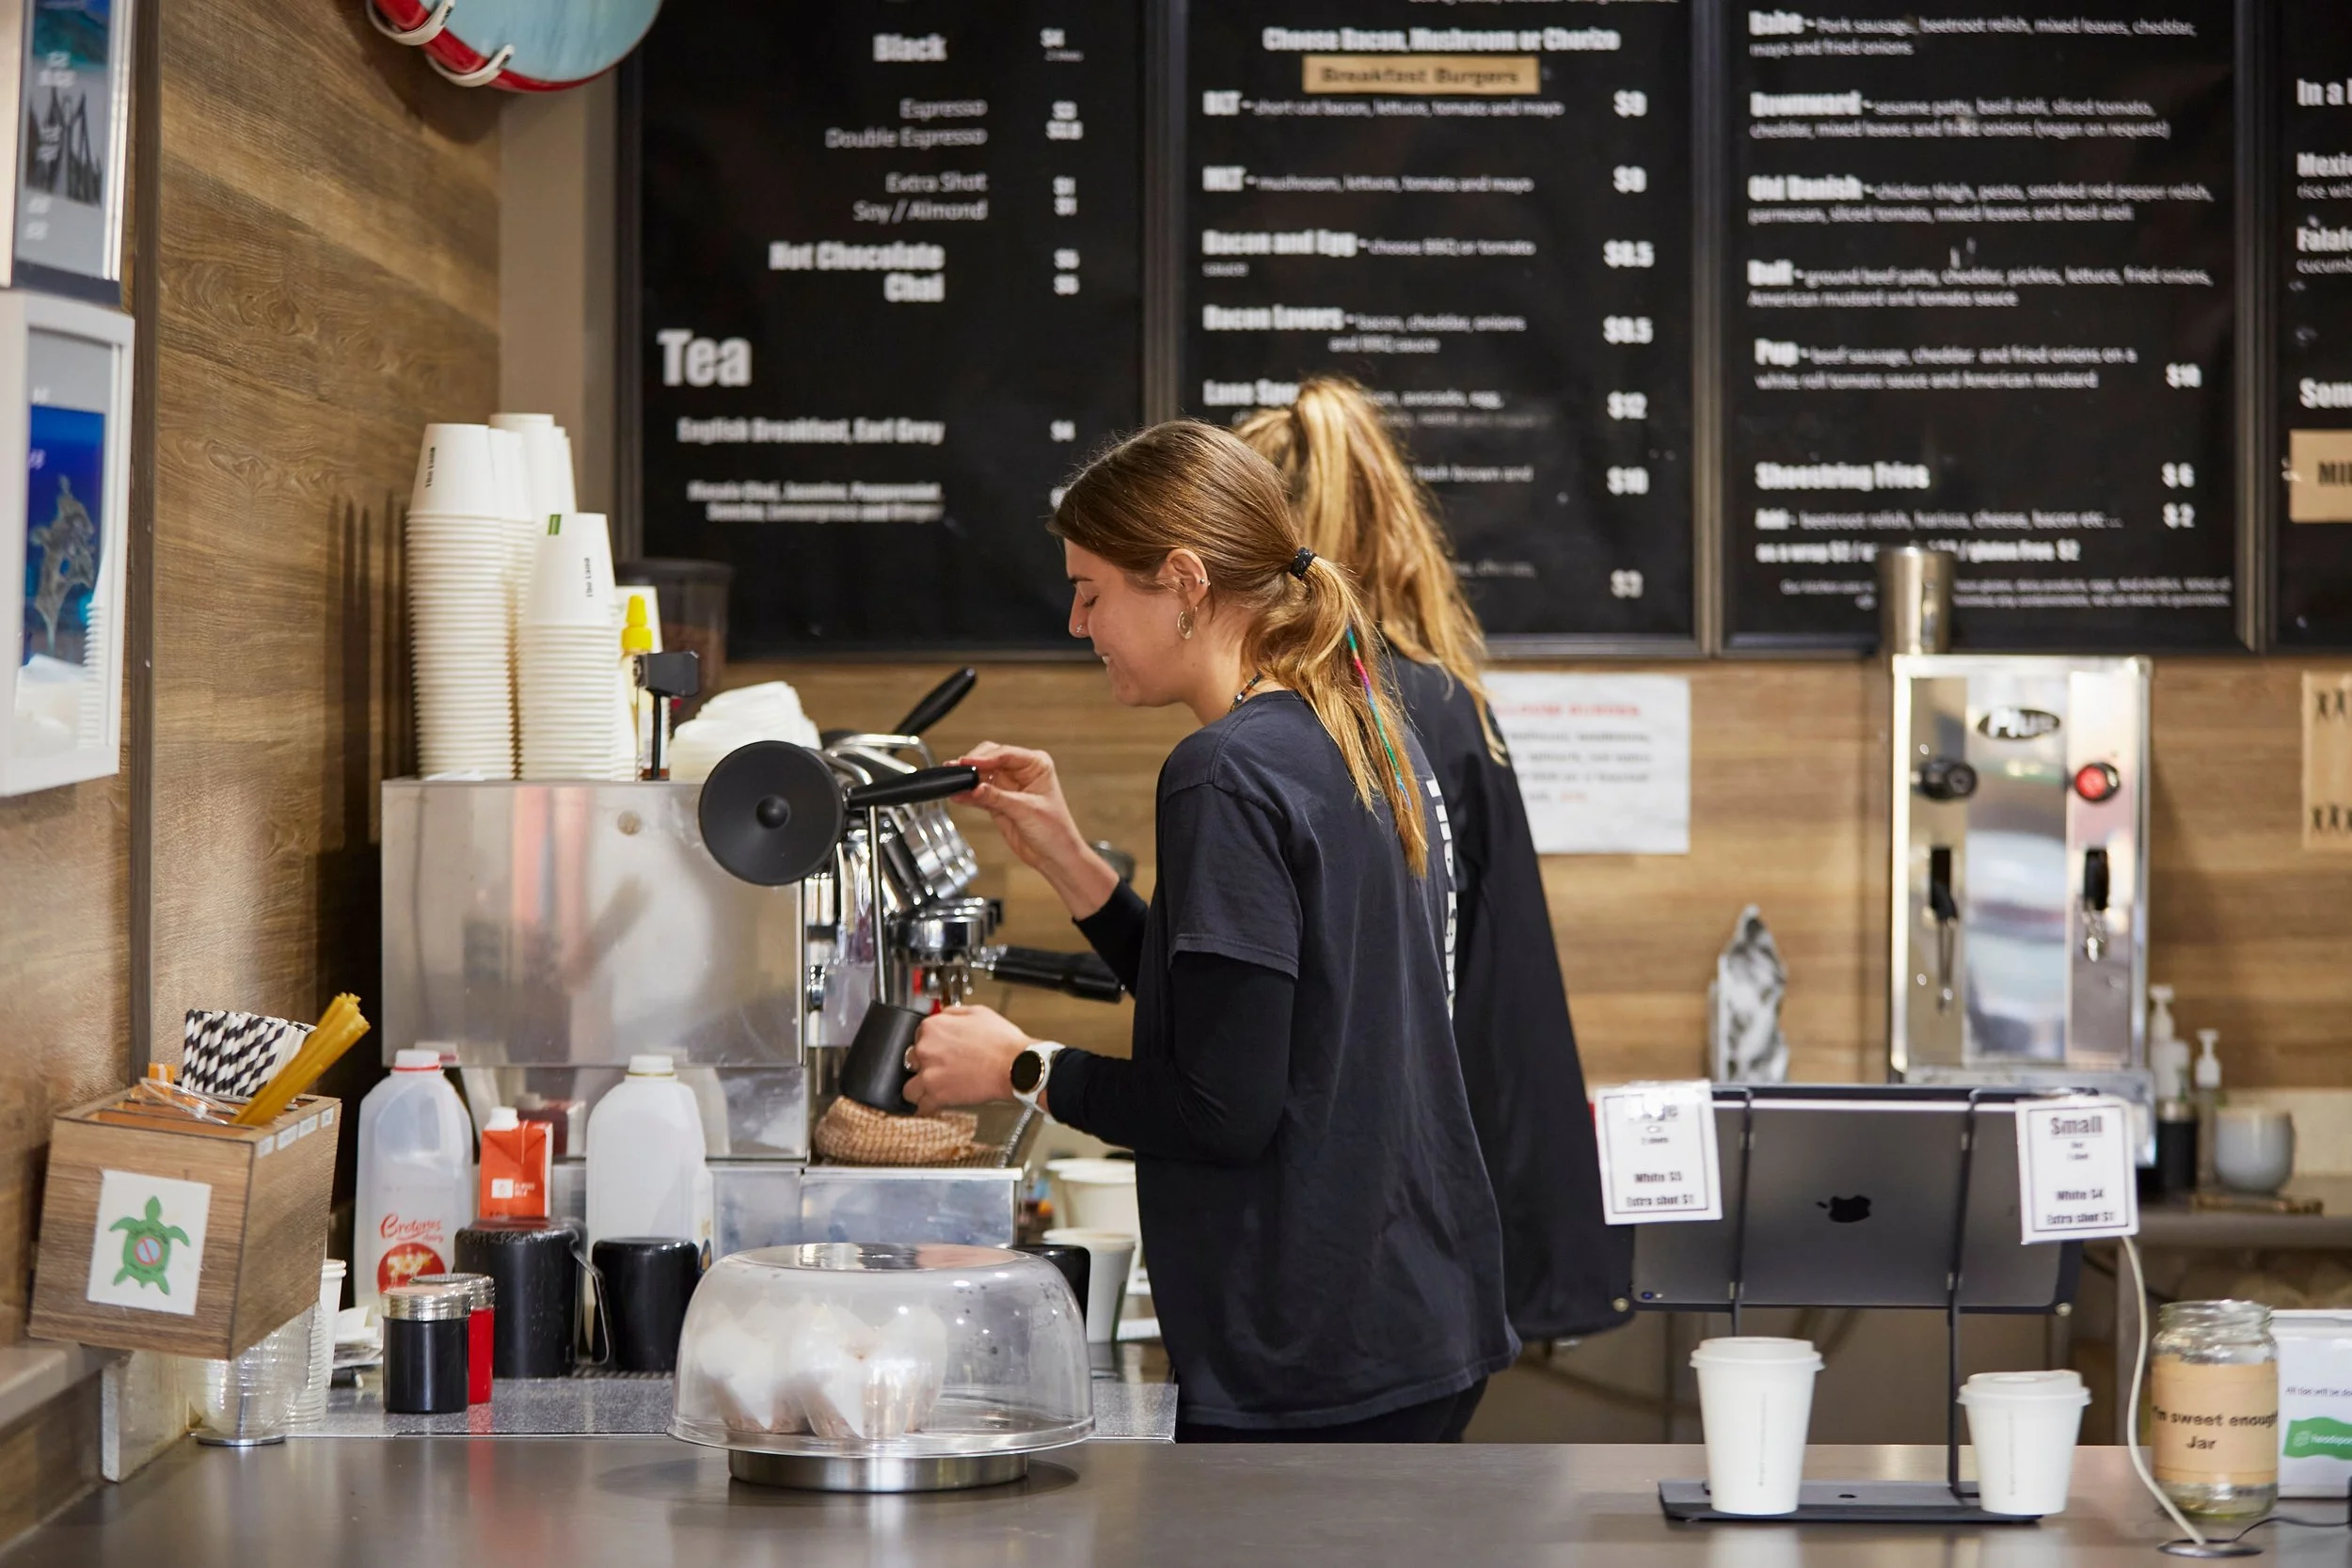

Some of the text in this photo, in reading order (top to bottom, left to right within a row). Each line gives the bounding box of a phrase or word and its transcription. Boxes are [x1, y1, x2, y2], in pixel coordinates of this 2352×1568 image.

[874, 34, 946, 61] Black
[1321, 66, 1518, 87] Breakfast Burgers
[2297, 79, 2324, 105] In
[2327, 83, 2344, 105] a
[900, 99, 988, 120] Espresso
[826, 127, 988, 149] Double Espresso
[886, 172, 987, 193] Extra Shot
[853, 201, 891, 223] Soy
[908, 200, 988, 220] Almond
[770, 242, 945, 270] Hot Chocolate
[884, 273, 945, 302] Chai
[658, 329, 751, 387] Tea
[2050, 1116, 2103, 1136] Small
[2056, 1190, 2087, 1202] White
[2170, 1413, 2224, 1427] sweet
[2186, 1435, 2217, 1449] Jar
